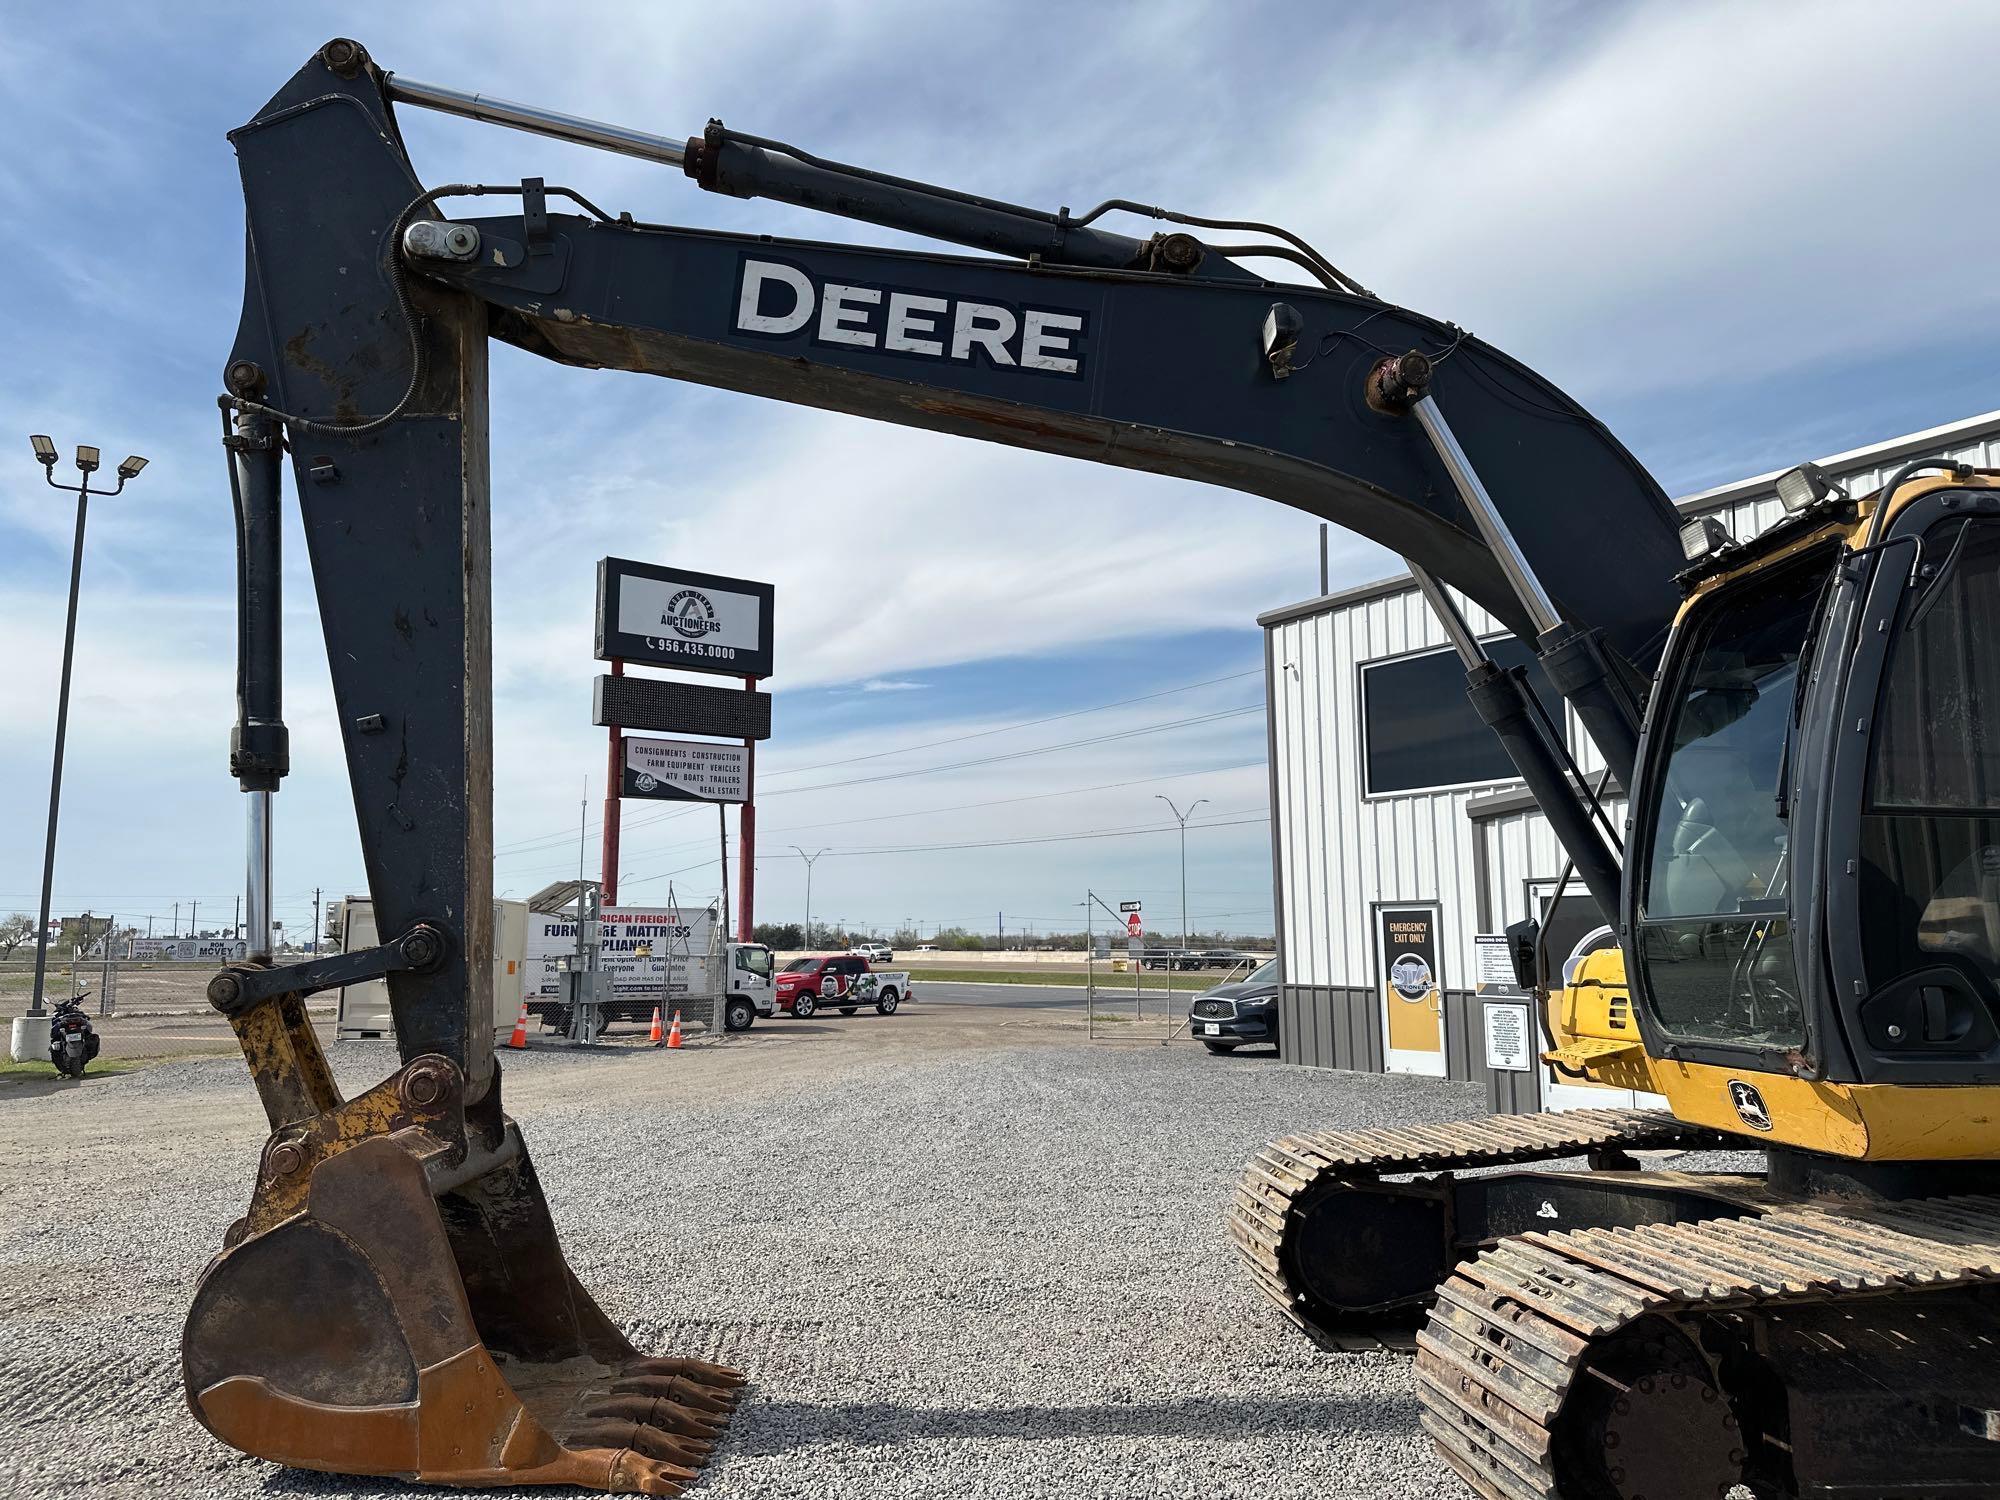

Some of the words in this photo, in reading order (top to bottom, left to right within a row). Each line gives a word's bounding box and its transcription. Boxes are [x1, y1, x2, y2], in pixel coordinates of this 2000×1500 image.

[737, 259, 1083, 374] DEERE
[660, 614, 721, 632] AUCTIONEERS
[658, 638, 735, 660] 956.435.0000
[634, 746, 687, 758] CONSIGNMENTS
[692, 751, 741, 762] CONSTRUCTION
[647, 758, 665, 768] FARM
[667, 760, 704, 770] EQUIPMENT
[710, 764, 740, 773] VEHICLES
[666, 772, 678, 780] ATV
[684, 774, 704, 782] BOATS
[710, 775, 740, 784] TRAILERS
[700, 786, 716, 794] REAL
[718, 786, 740, 796] ESTATE
[634, 915, 676, 924] FREIGHT
[626, 926, 691, 938] MATTRESS
[1128, 924, 1140, 936] STOP
[1390, 922, 1428, 932] EMERGENCY
[1394, 934, 1408, 943] EXIT
[1409, 933, 1426, 943] ONLY
[199, 948, 234, 956] MCVEY
[604, 964, 634, 972] Everyone
